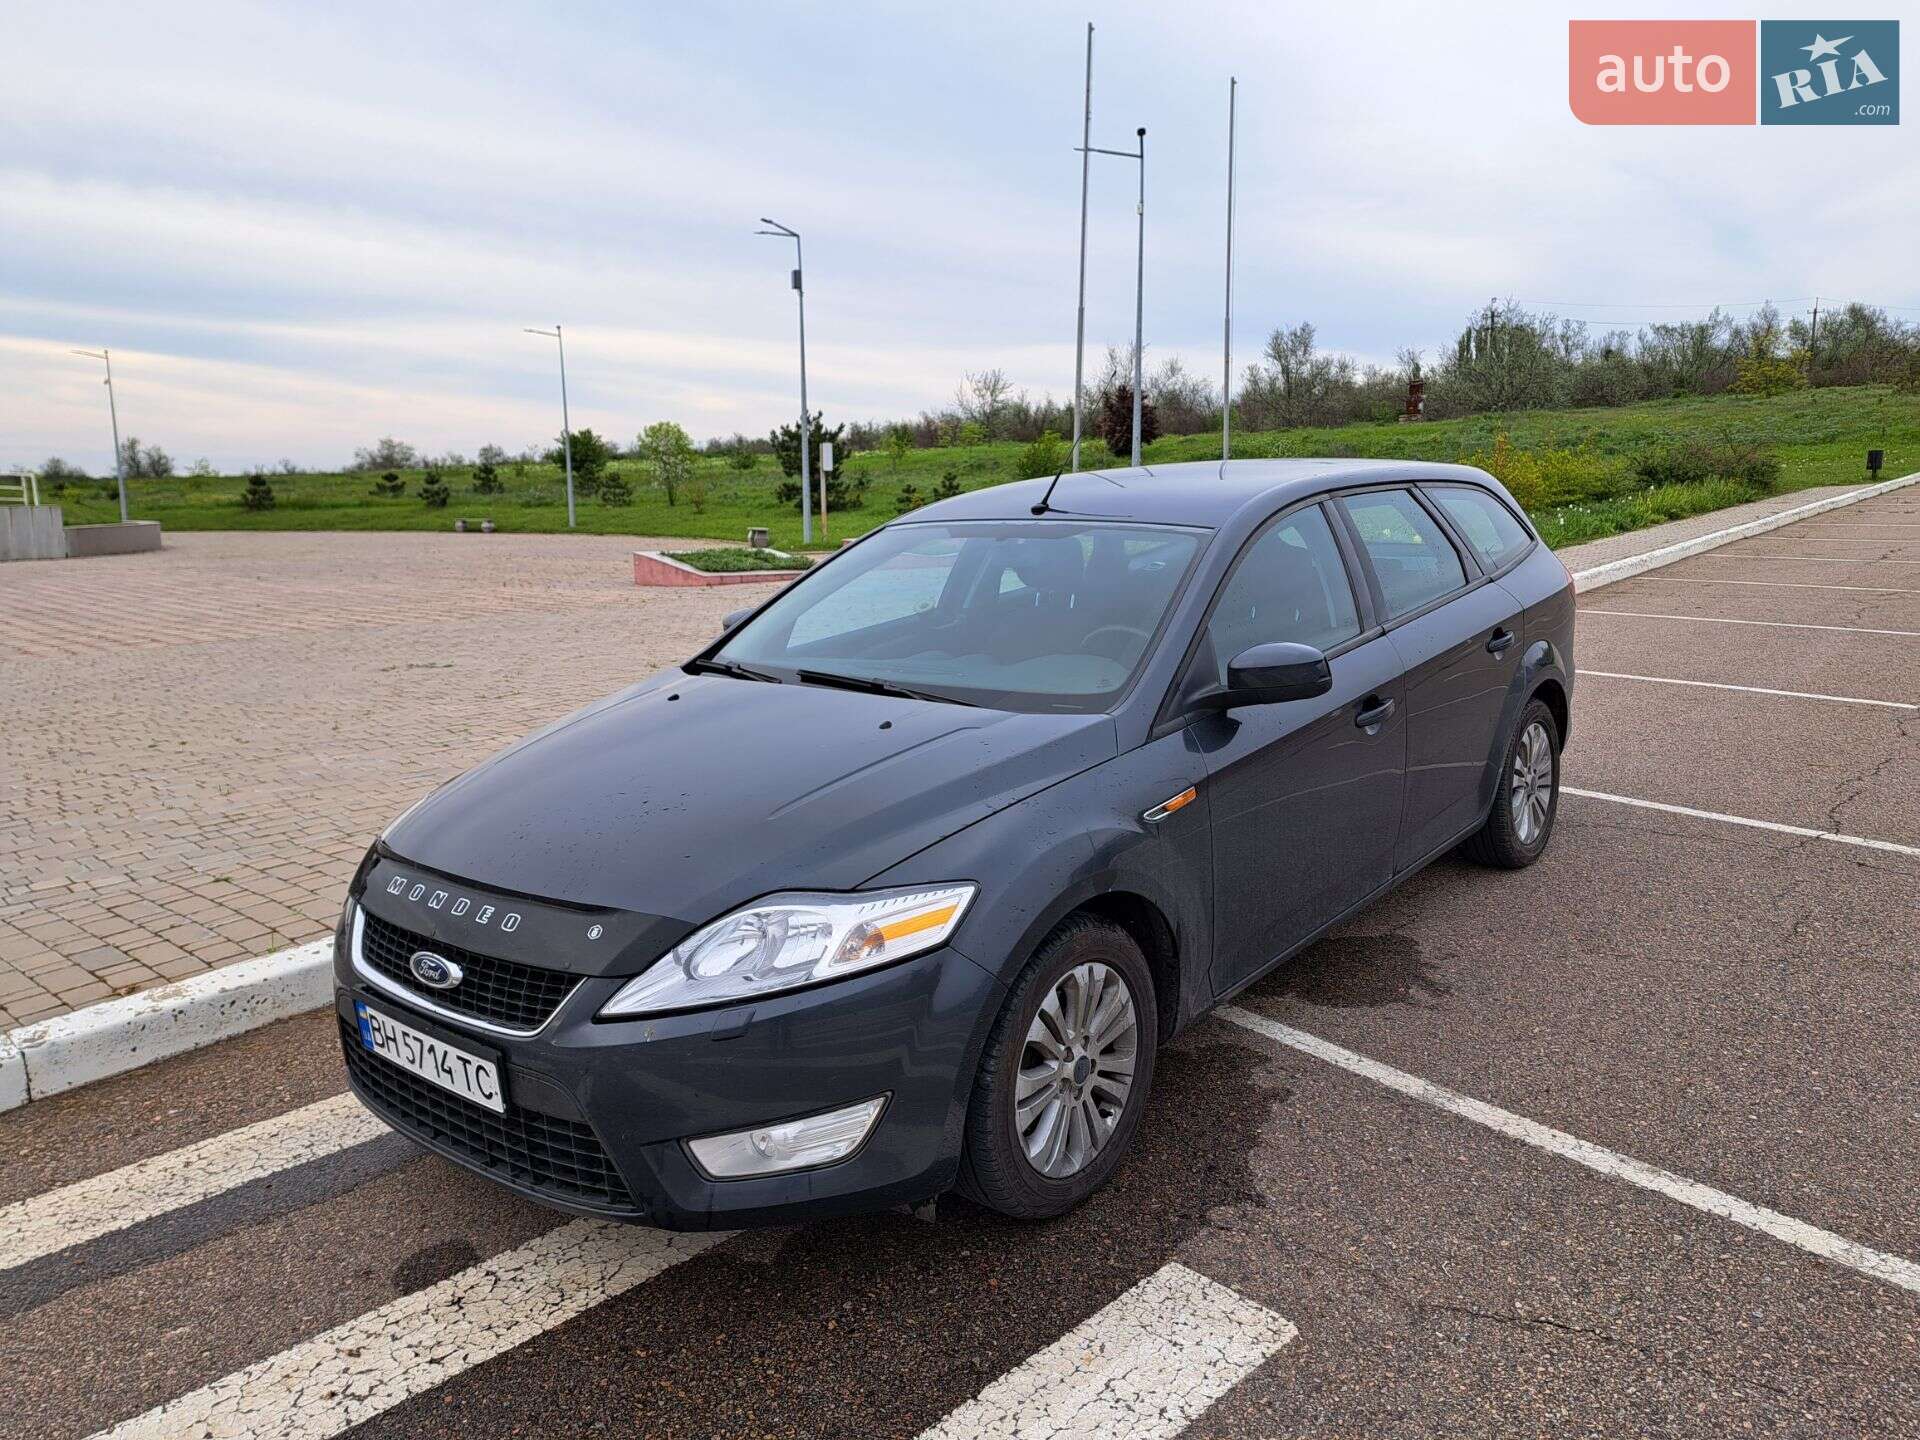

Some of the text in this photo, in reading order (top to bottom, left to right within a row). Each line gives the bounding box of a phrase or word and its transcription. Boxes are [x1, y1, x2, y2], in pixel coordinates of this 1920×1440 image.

[386, 875, 521, 932] MONDEO
[418, 959, 442, 980] Ford
[369, 1012, 494, 1100] BH 5714 TC
